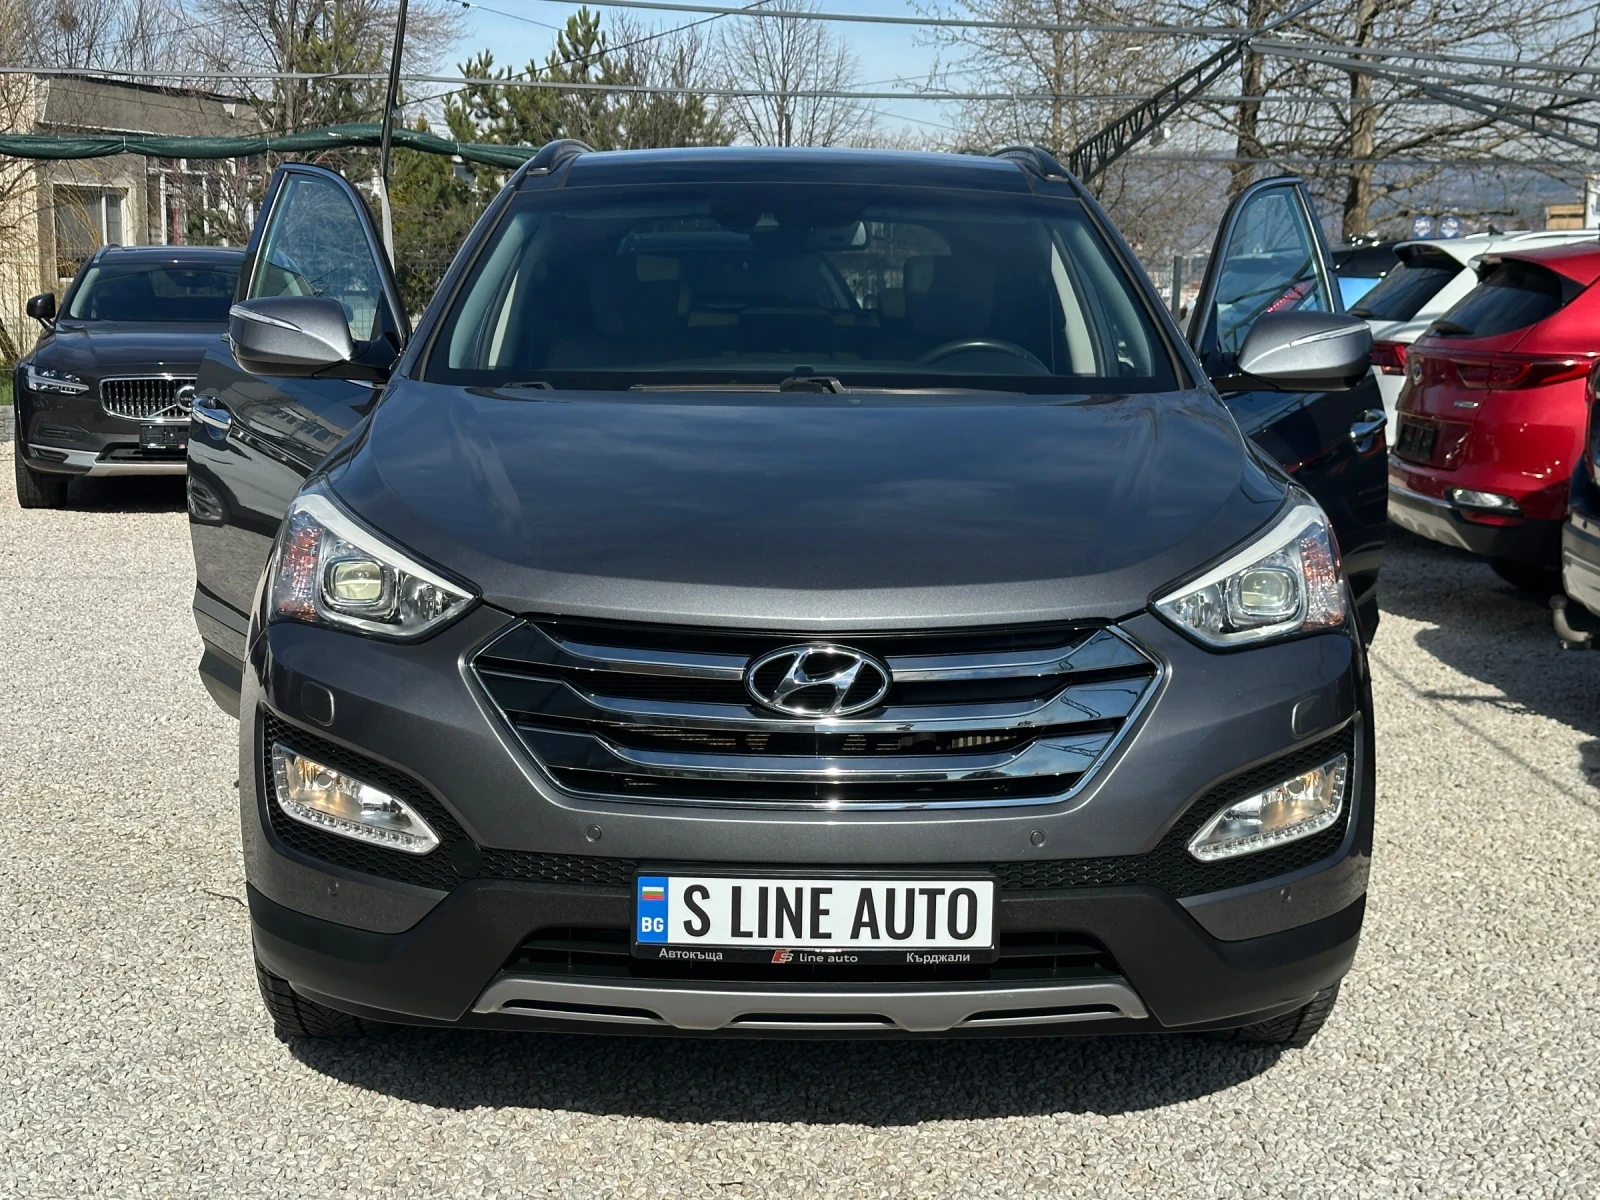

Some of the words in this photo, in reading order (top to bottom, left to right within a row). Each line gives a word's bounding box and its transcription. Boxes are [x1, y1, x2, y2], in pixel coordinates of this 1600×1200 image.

[683, 884, 711, 938] S
[730, 886, 833, 940] LINE
[849, 887, 978, 941] AUTO
[641, 917, 664, 933] BG
[658, 947, 723, 961] Автокъща
[799, 952, 825, 963] line
[827, 953, 859, 963] auto
[906, 952, 971, 964] Кърджали
